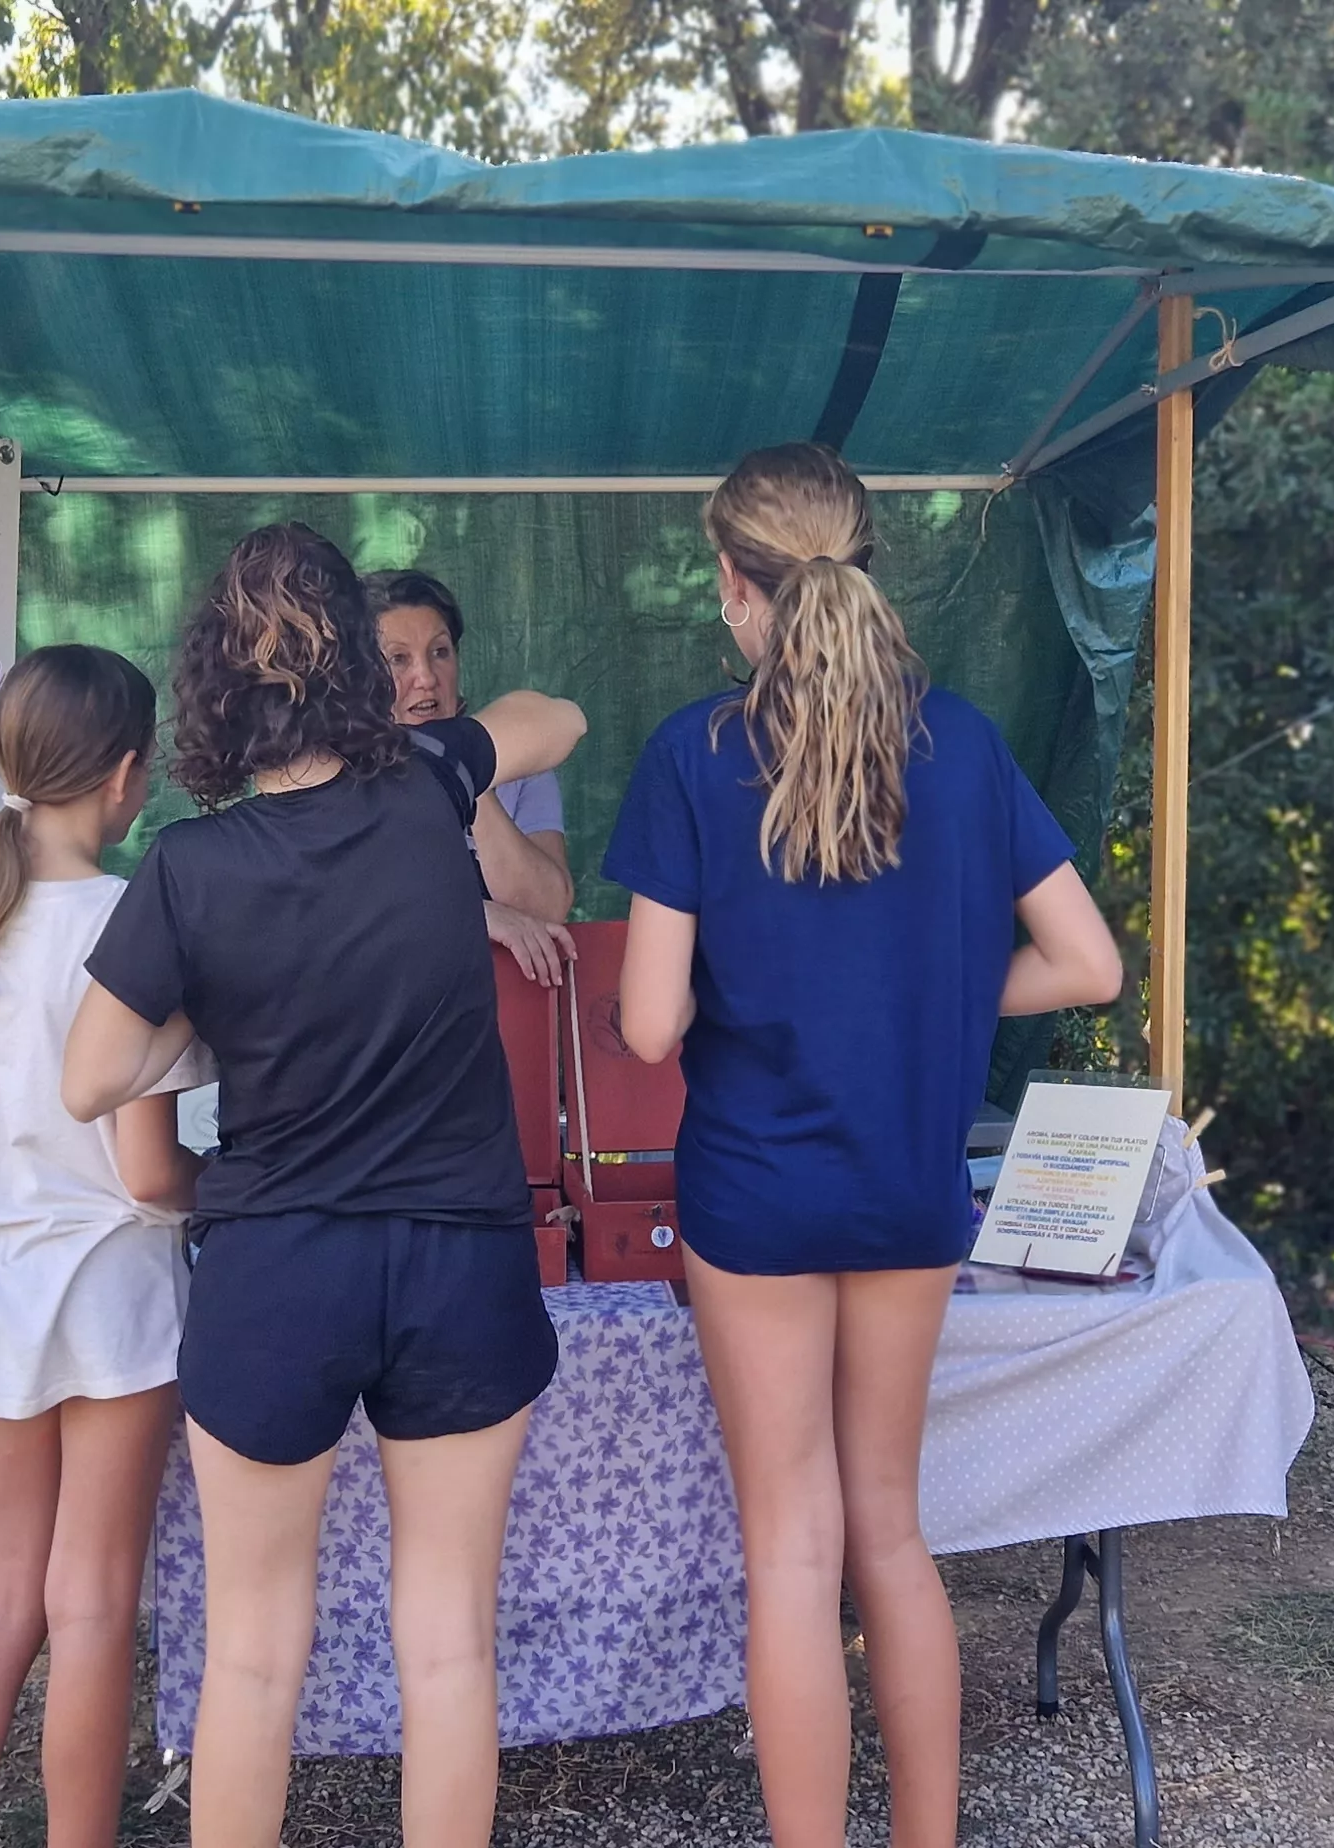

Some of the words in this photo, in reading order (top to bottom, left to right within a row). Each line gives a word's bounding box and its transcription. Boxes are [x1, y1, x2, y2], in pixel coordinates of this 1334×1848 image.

[1078, 1134, 1100, 1142] COLOR
[1101, 1135, 1110, 1143] EN
[1111, 1136, 1123, 1144] TUS
[1123, 1137, 1148, 1146] PLATOS
